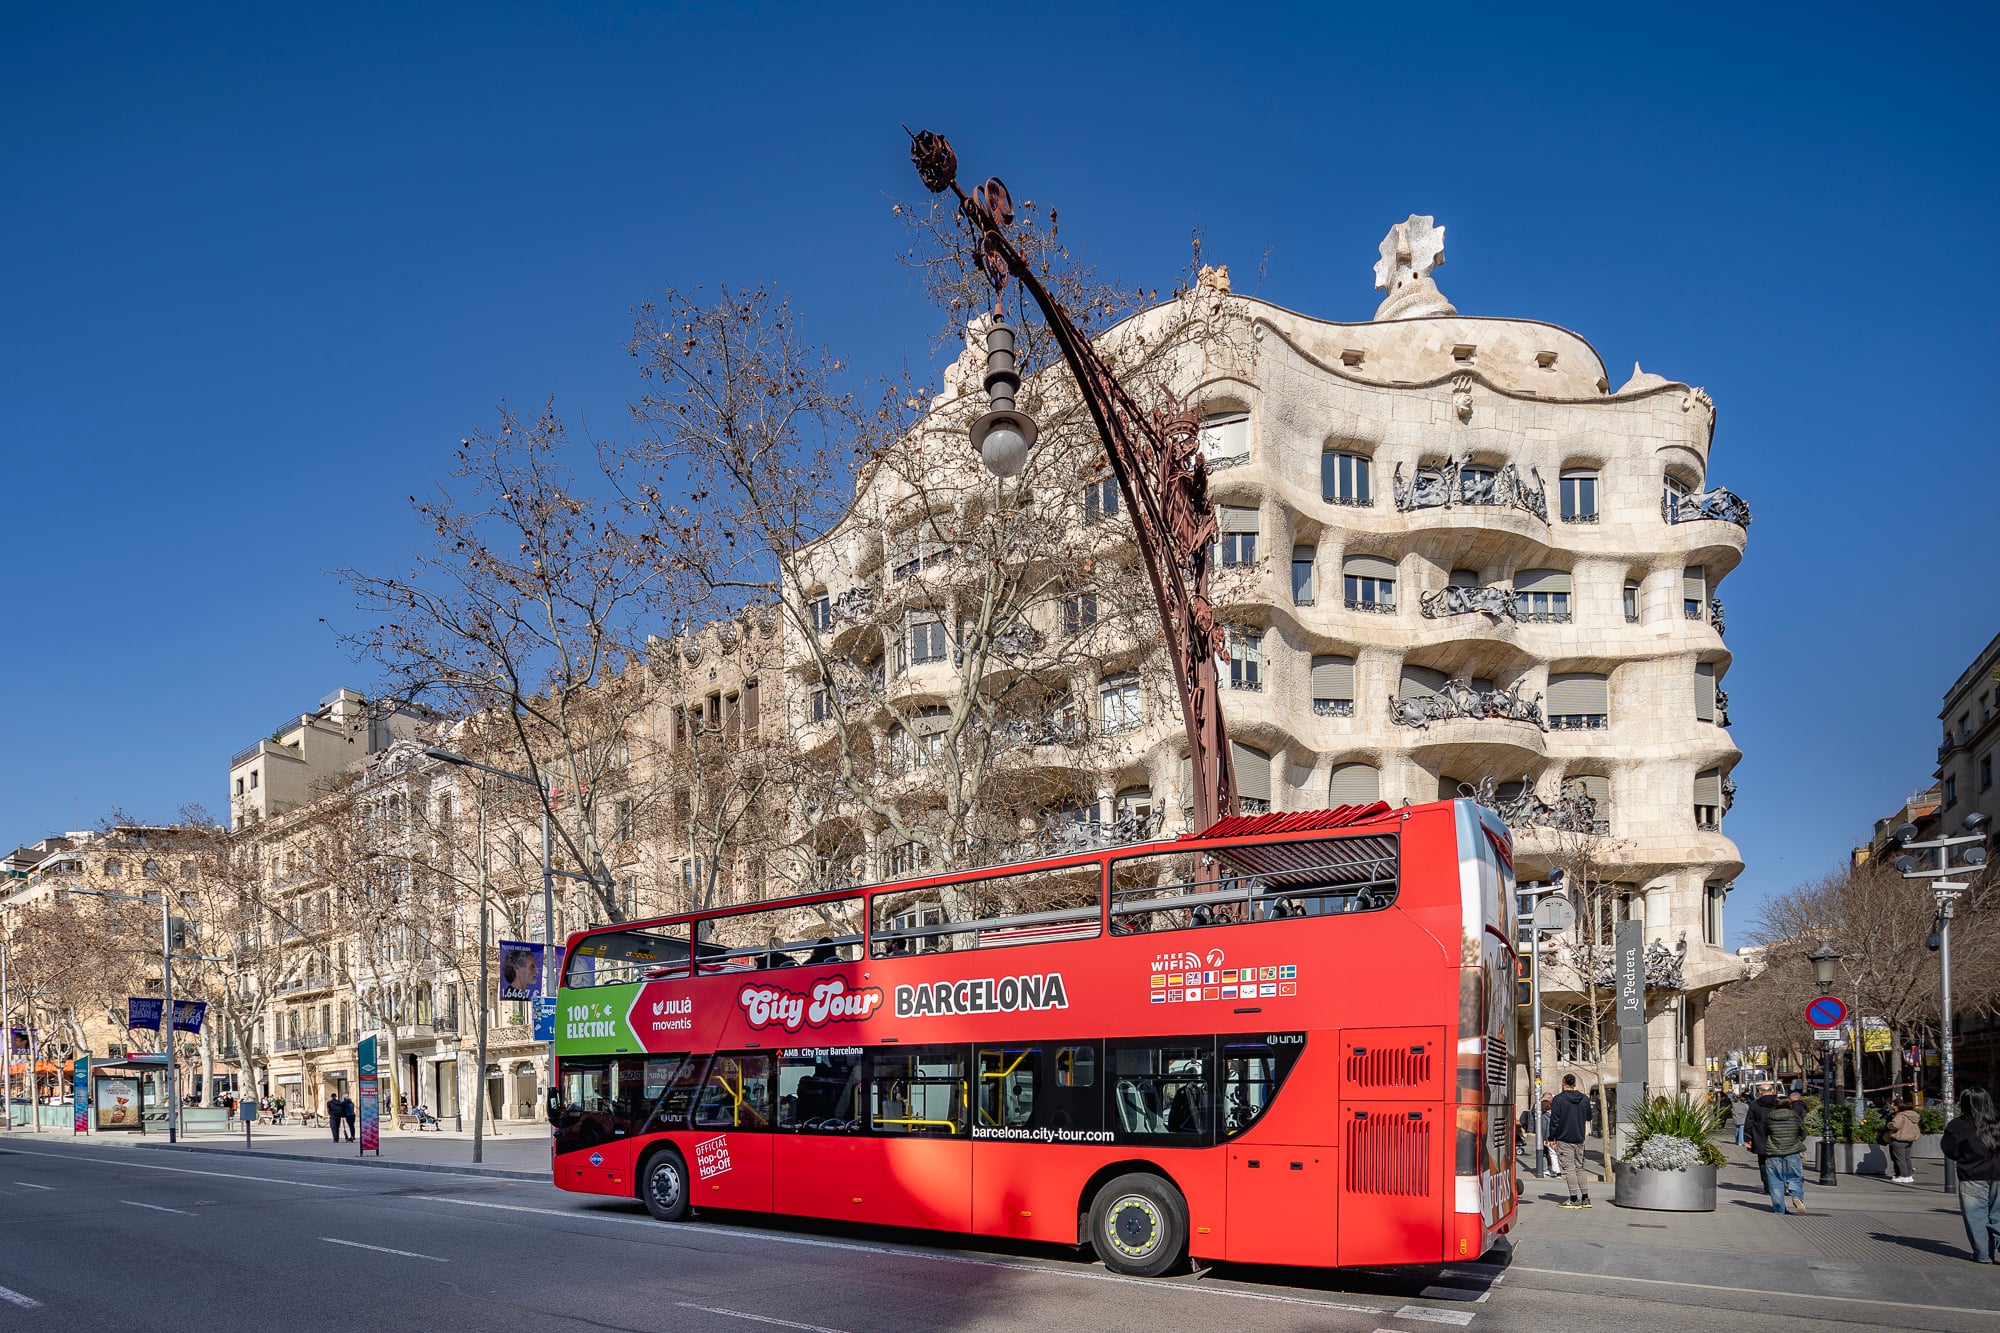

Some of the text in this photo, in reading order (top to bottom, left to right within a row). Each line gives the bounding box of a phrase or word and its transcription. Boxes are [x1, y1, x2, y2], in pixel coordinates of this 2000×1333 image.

[1151, 959, 1183, 972] WIFI
[1157, 952, 1183, 961] FREE
[1623, 948, 1639, 1011] La Pedrera
[741, 981, 879, 1028] City Tour
[896, 973, 1069, 1018] BARCELONA
[567, 1004, 589, 1022] 100
[566, 1020, 616, 1039] ELECTRIC
[652, 1017, 692, 1031] moventis
[783, 1045, 864, 1058] AMB City Tour Barcelona
[972, 1125, 1115, 1143] barcelona.city-tour.com
[695, 1137, 728, 1156] OFFICIAL
[697, 1148, 729, 1167] Hop-On
[699, 1156, 731, 1177] Hop-Off
